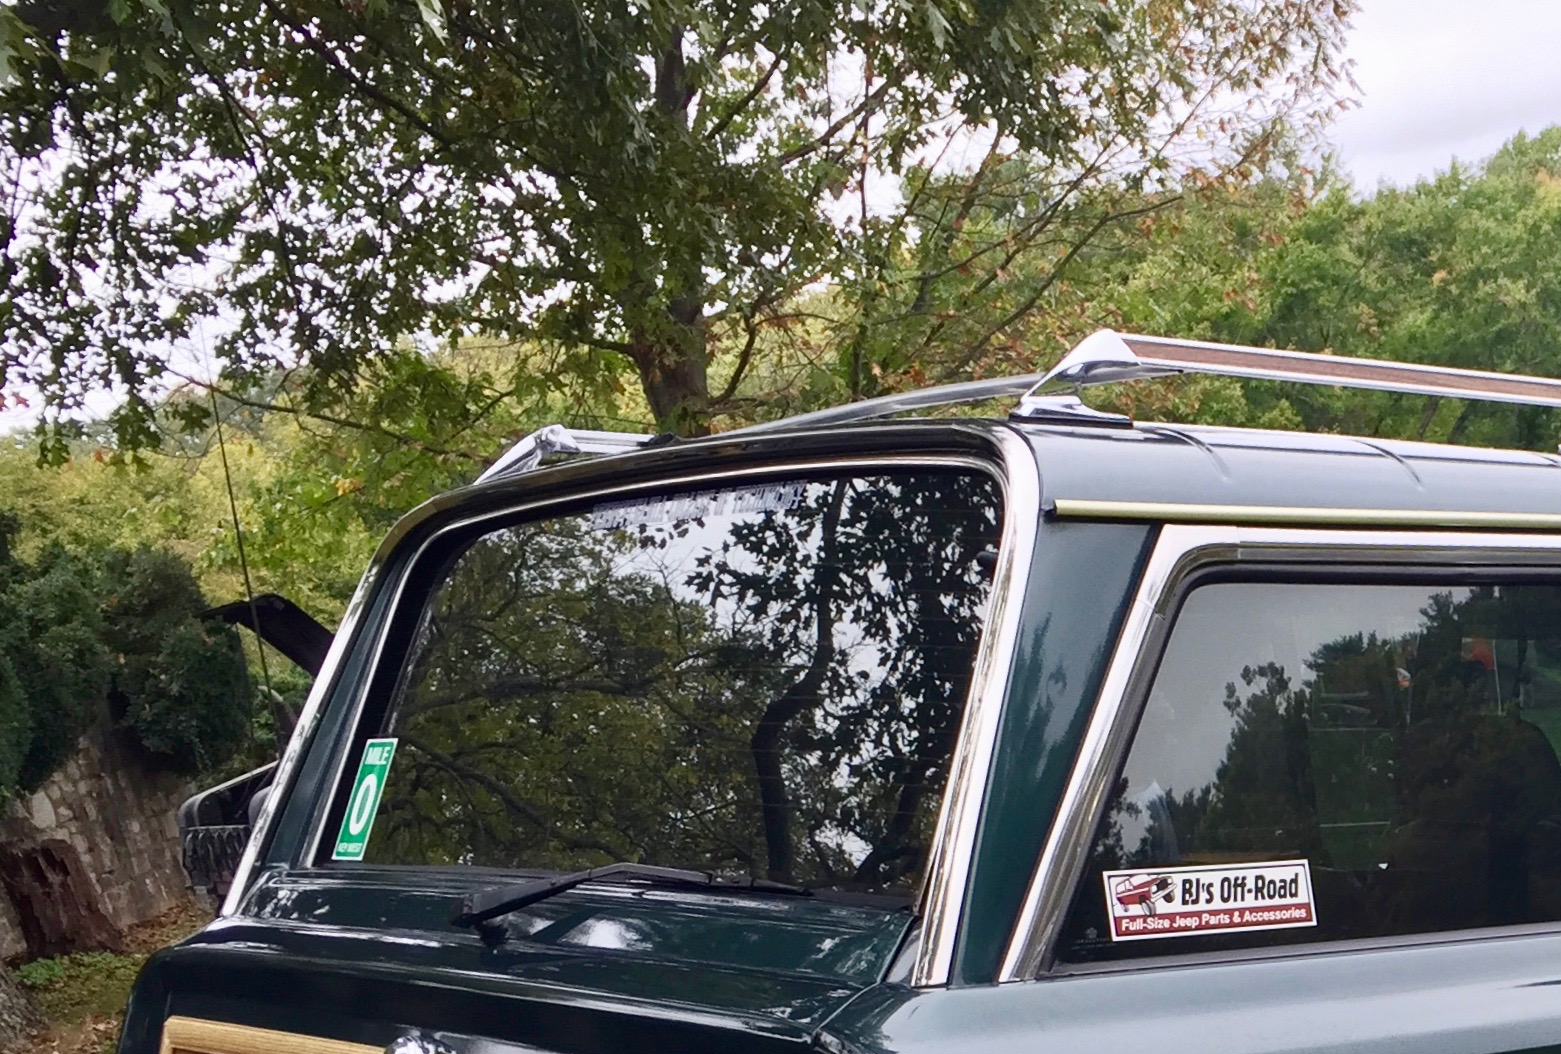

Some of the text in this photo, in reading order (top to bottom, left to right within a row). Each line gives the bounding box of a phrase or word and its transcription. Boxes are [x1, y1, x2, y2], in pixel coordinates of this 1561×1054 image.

[364, 745, 392, 766] MILE
[348, 773, 378, 836] 0
[1181, 872, 1300, 907] BJ's Off-Road
[1121, 907, 1308, 932] Full-Size Jeep Parts & Accessories
